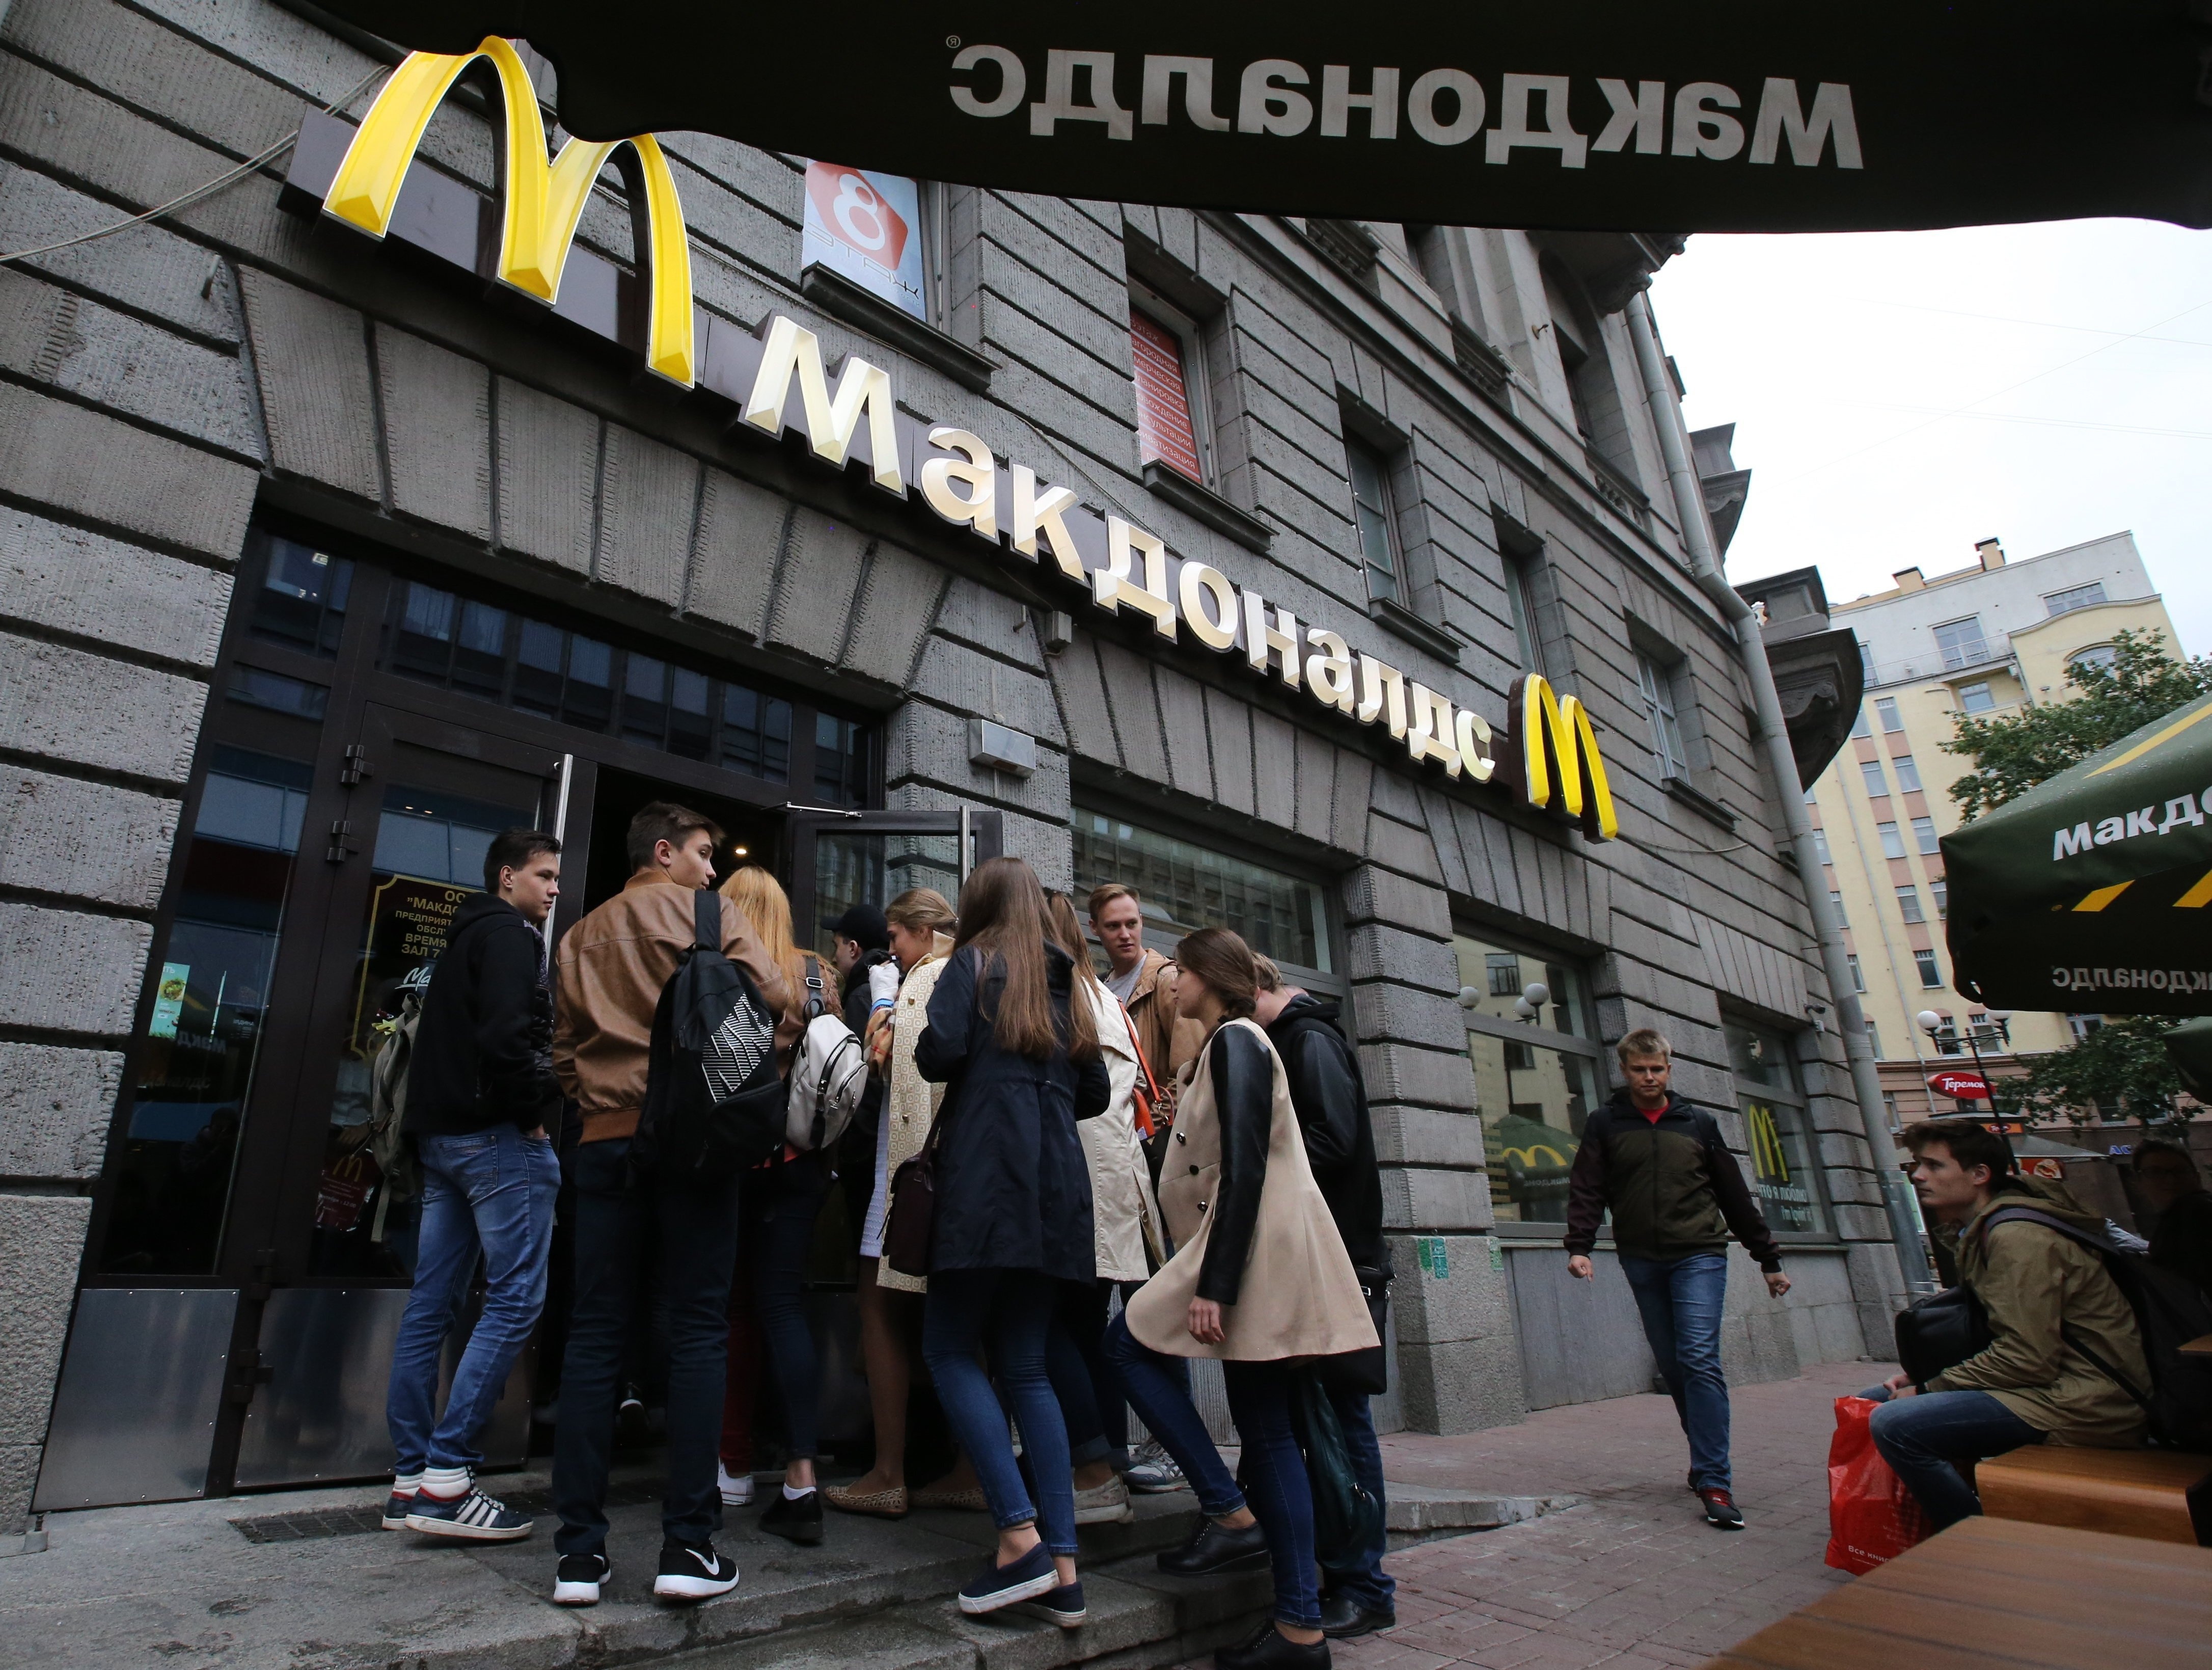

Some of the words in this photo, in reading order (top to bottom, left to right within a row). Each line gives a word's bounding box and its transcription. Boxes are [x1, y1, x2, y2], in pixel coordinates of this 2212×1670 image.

[1131, 337, 1178, 373] агородная
[1134, 355, 1181, 391] мерческая
[1136, 389, 1188, 429] овождение
[1136, 429, 1196, 470] риватизация
[745, 315, 1496, 781] Макдоналдс
[2053, 785, 2212, 861] Макд
[395, 910, 452, 926] ПРЕДПРИЯТ
[416, 924, 446, 935] ОБСЛ
[401, 944, 428, 957] ЗАЛ
[431, 949, 442, 958] 7
[405, 933, 447, 948] ВРЕМЯ
[1941, 1076, 1986, 1092] Теремок
[1848, 1545, 1865, 1556] Все
